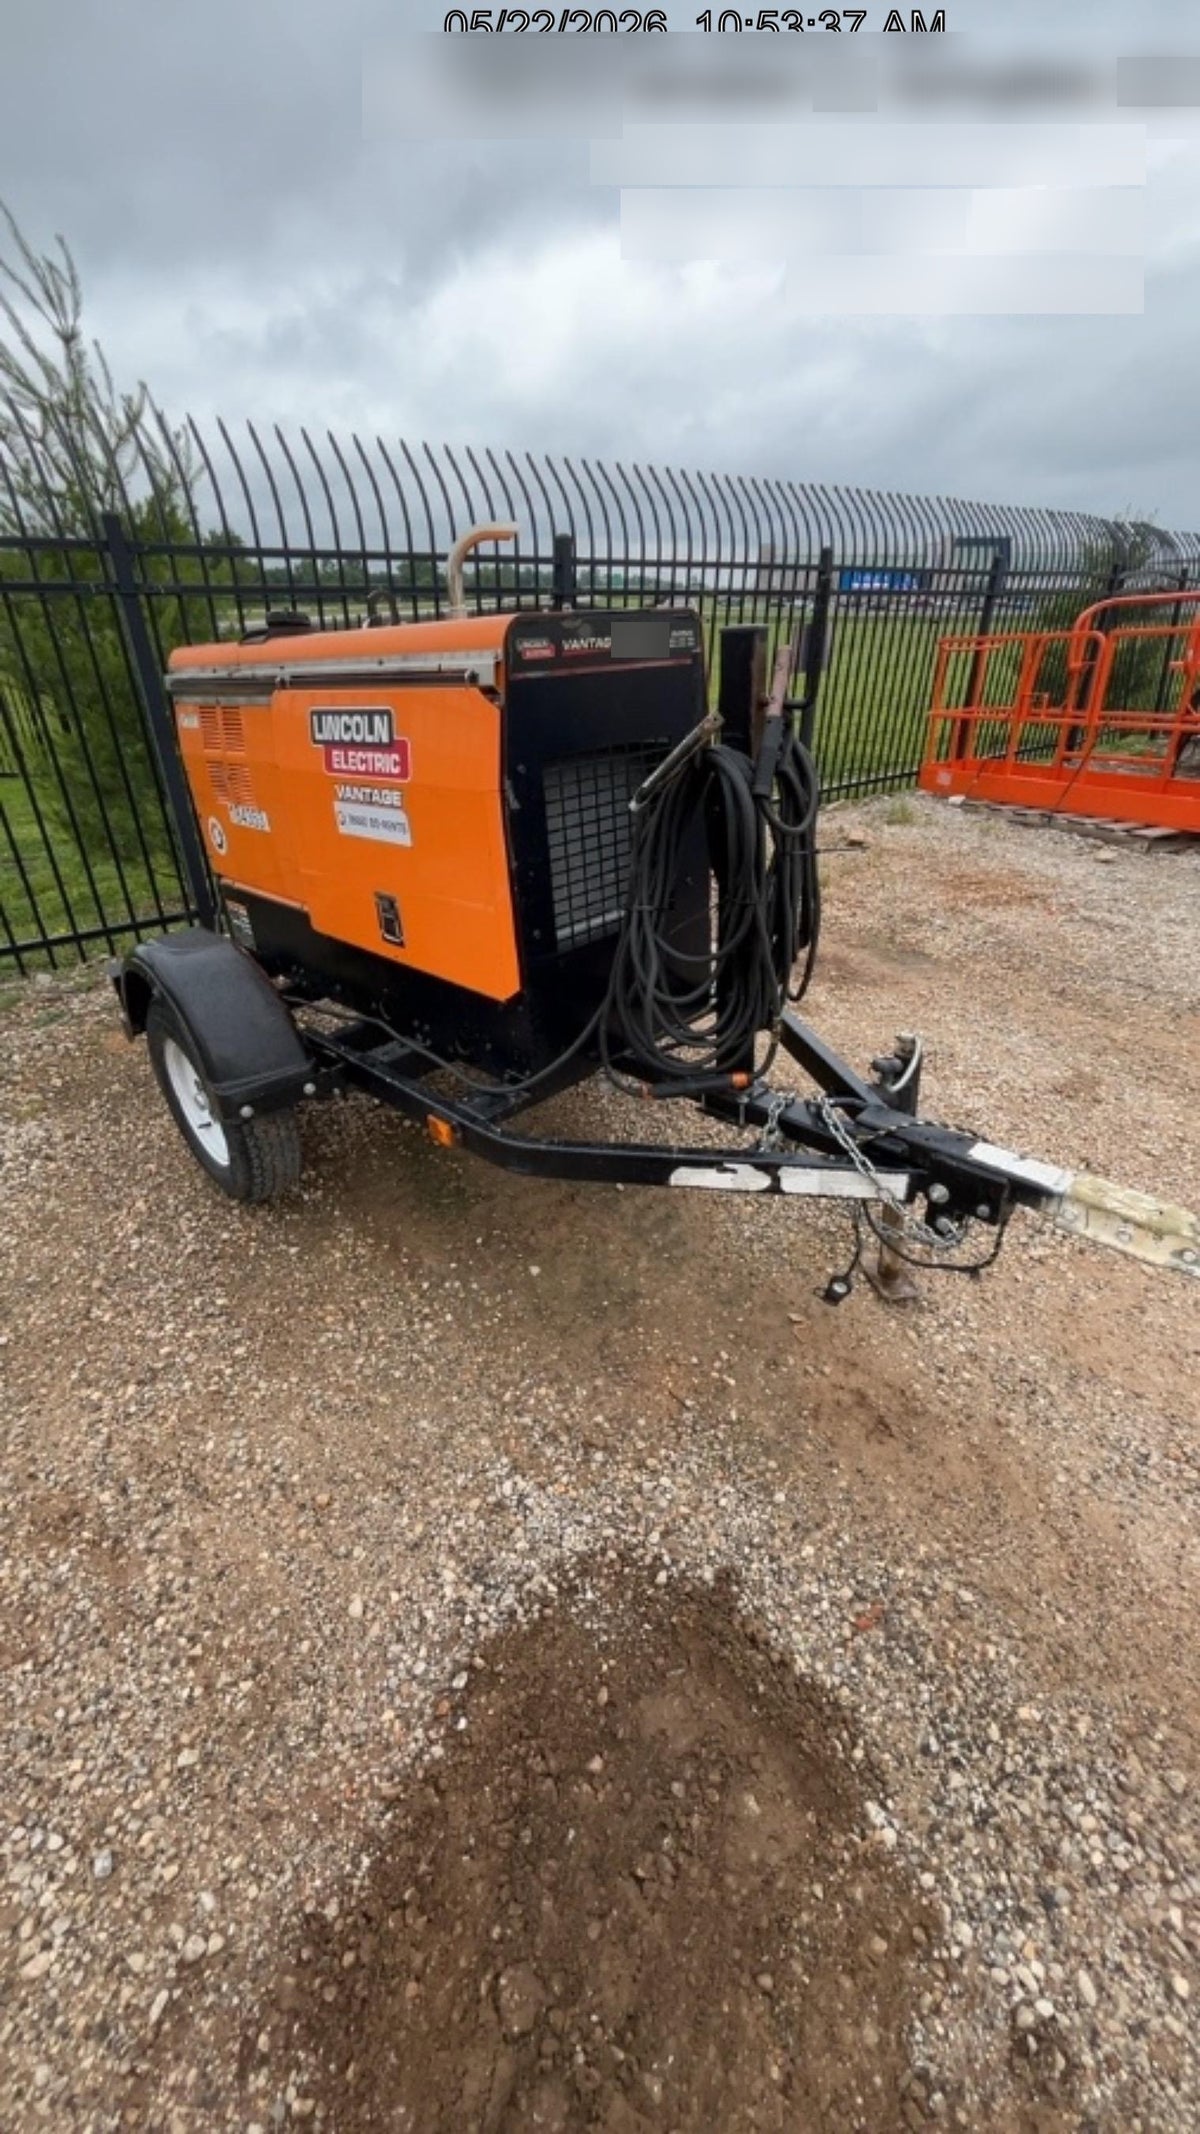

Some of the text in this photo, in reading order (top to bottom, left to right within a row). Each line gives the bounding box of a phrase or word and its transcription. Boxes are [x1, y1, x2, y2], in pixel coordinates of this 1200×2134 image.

[561, 636, 612, 651] VANTAG
[312, 714, 390, 743] LINCOLN
[331, 749, 401, 774] ELECTRIC
[334, 784, 403, 807] VANTAGE
